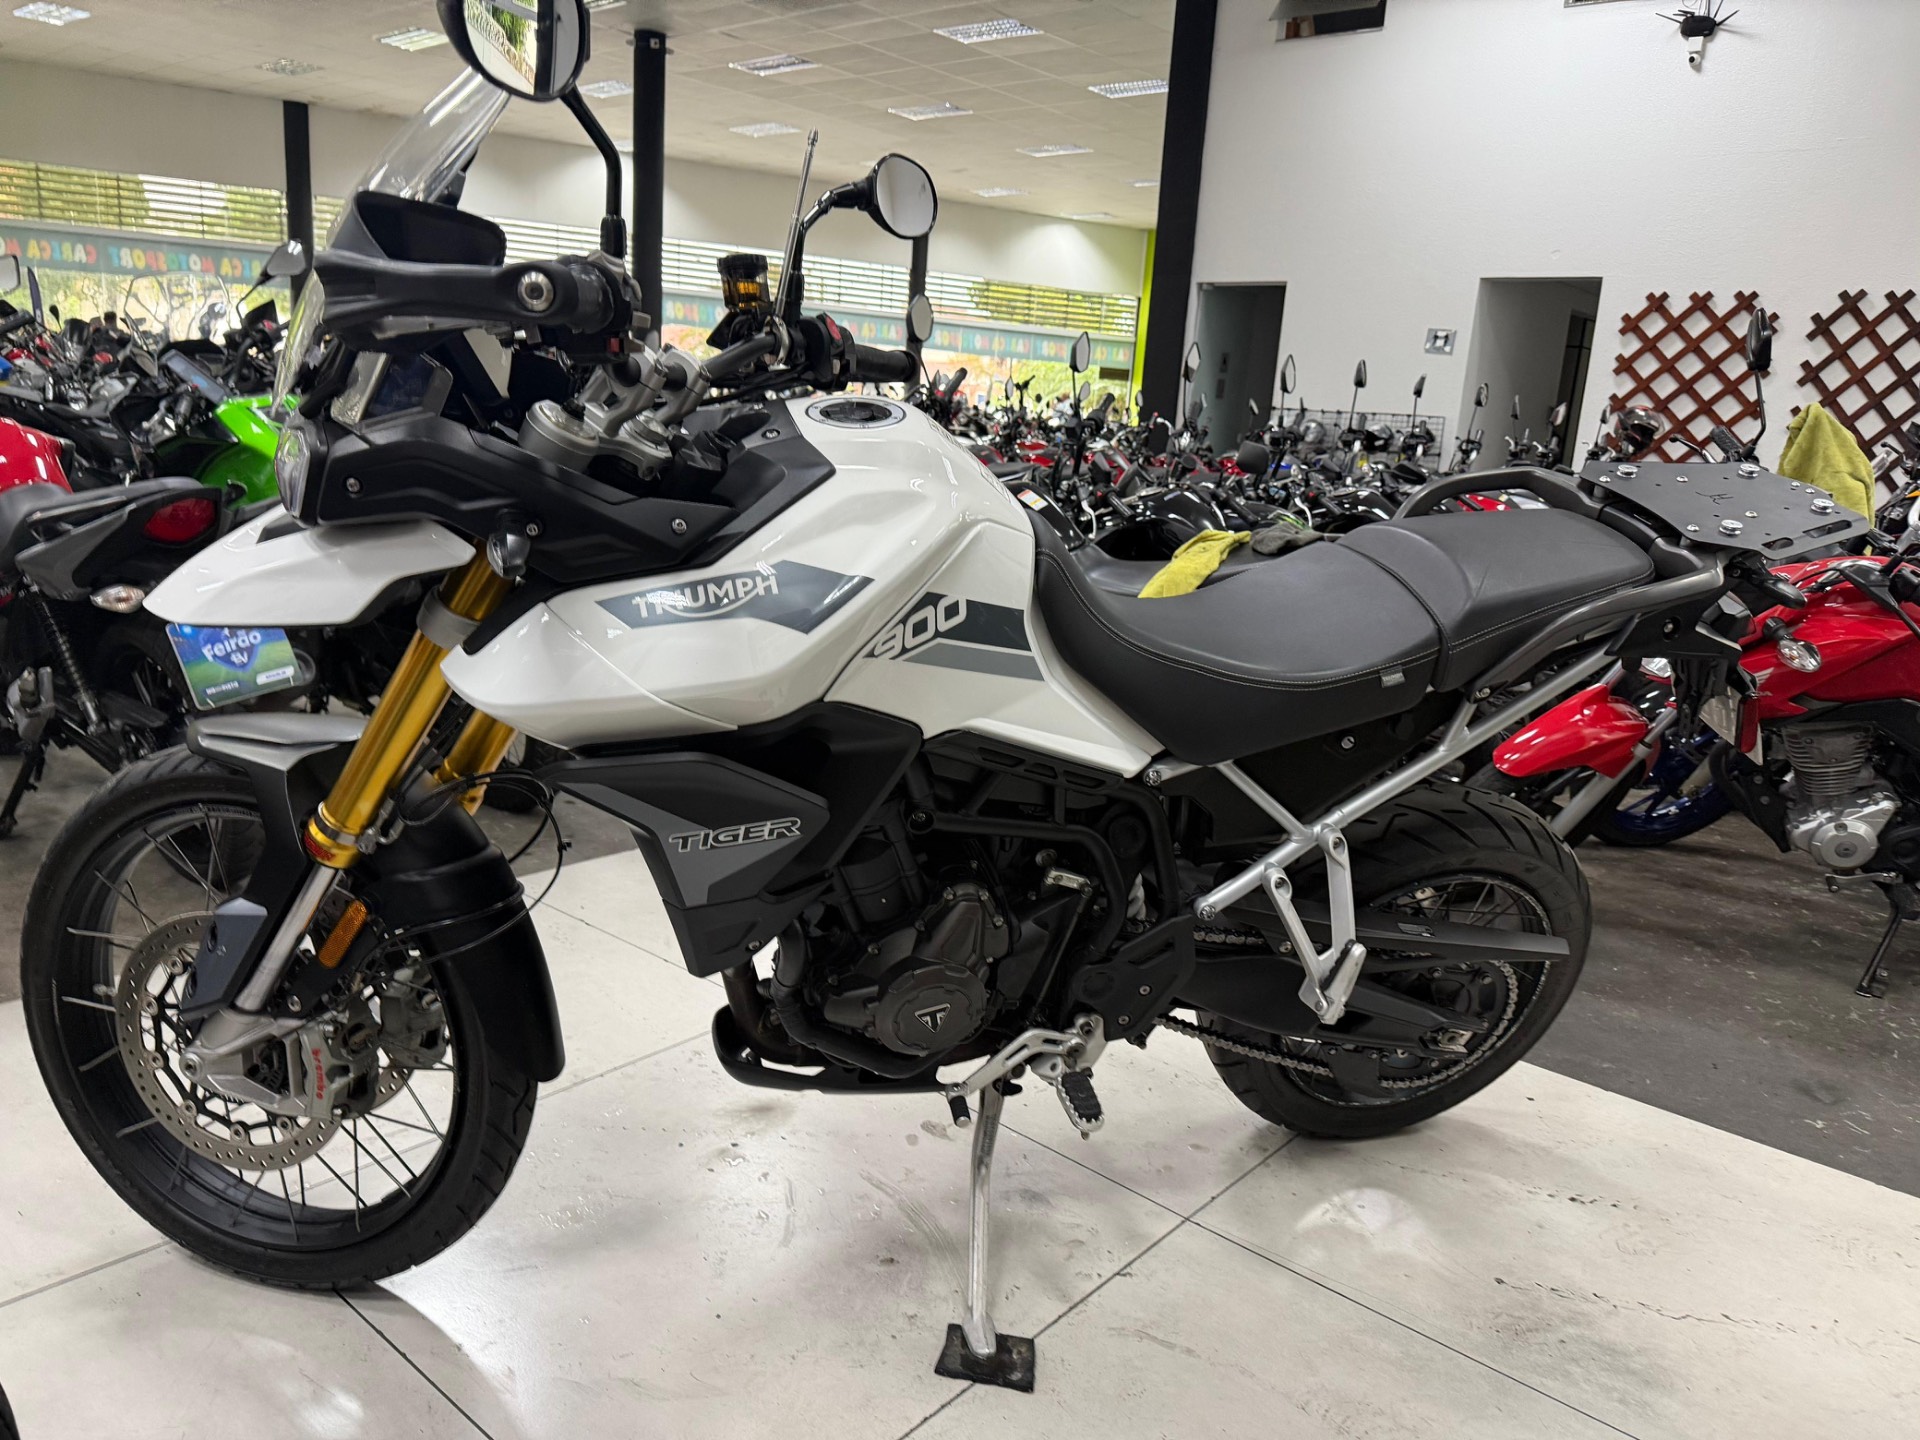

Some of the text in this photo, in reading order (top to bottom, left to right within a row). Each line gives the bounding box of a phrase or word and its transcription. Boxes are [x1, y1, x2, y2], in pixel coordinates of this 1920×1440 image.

[632, 574, 779, 619] TRIUMPH
[201, 629, 262, 662] Feirão
[873, 594, 967, 660] 900
[669, 817, 801, 852] TIGER
[312, 1047, 326, 1101] brembo
